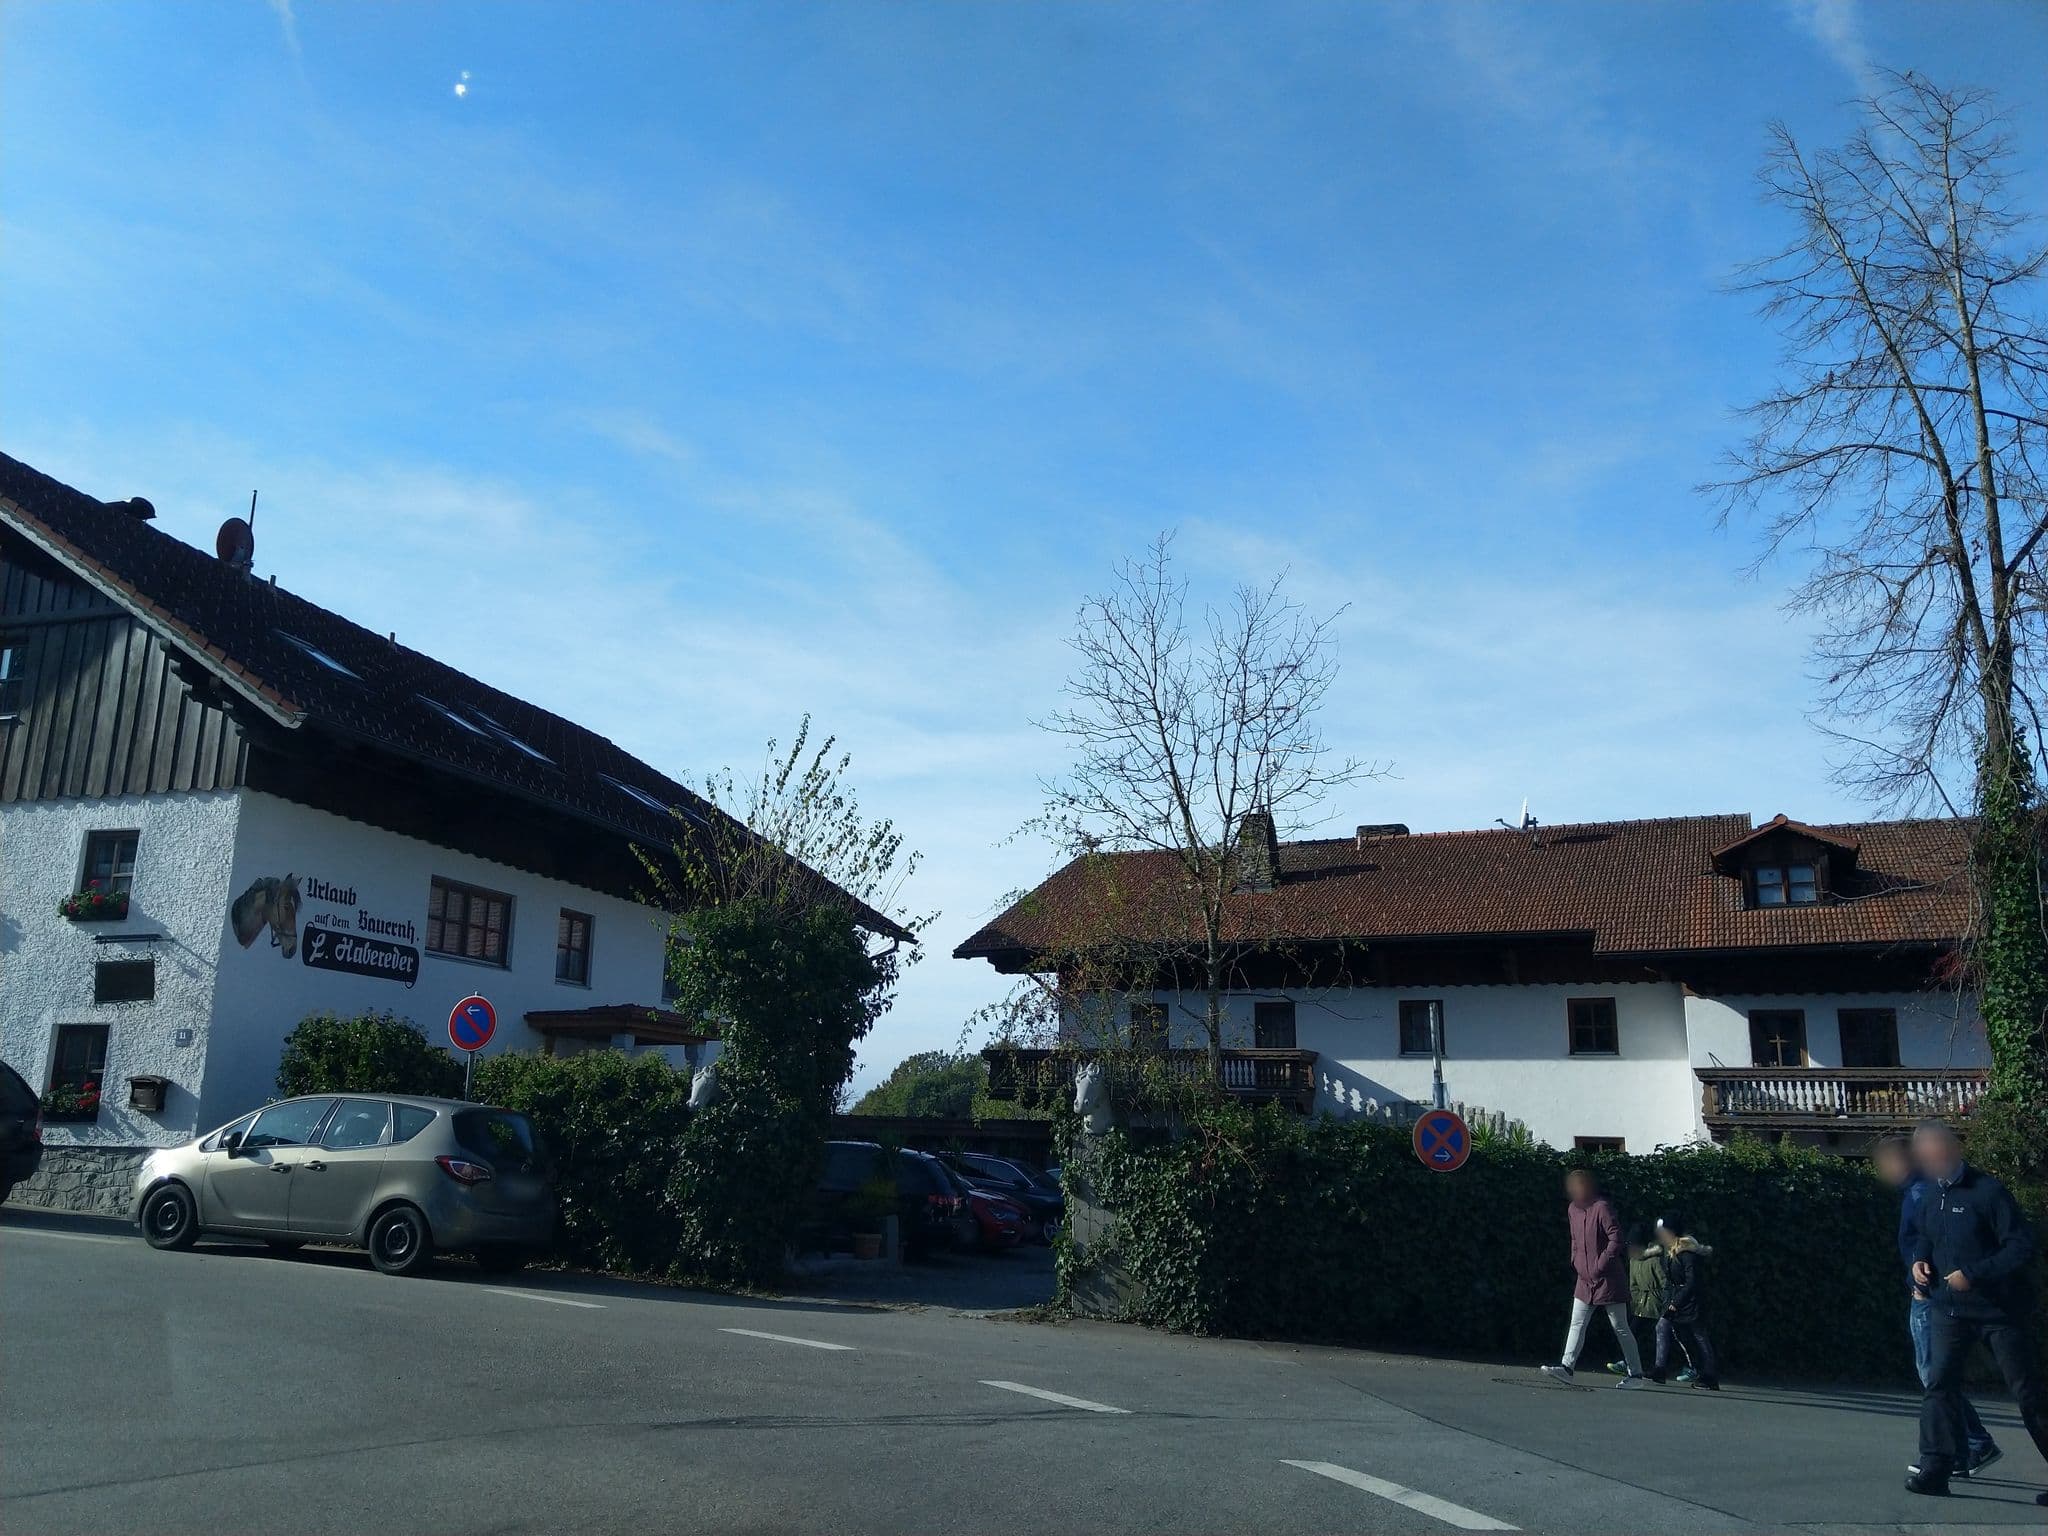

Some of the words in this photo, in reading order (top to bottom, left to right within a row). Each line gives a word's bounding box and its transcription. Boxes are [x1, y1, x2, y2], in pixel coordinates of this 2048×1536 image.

[306, 876, 357, 906] Urlaub
[314, 913, 331, 928] auf
[332, 914, 351, 929] dem
[358, 908, 420, 945] Bauernh.
[334, 937, 414, 973] Habereder
